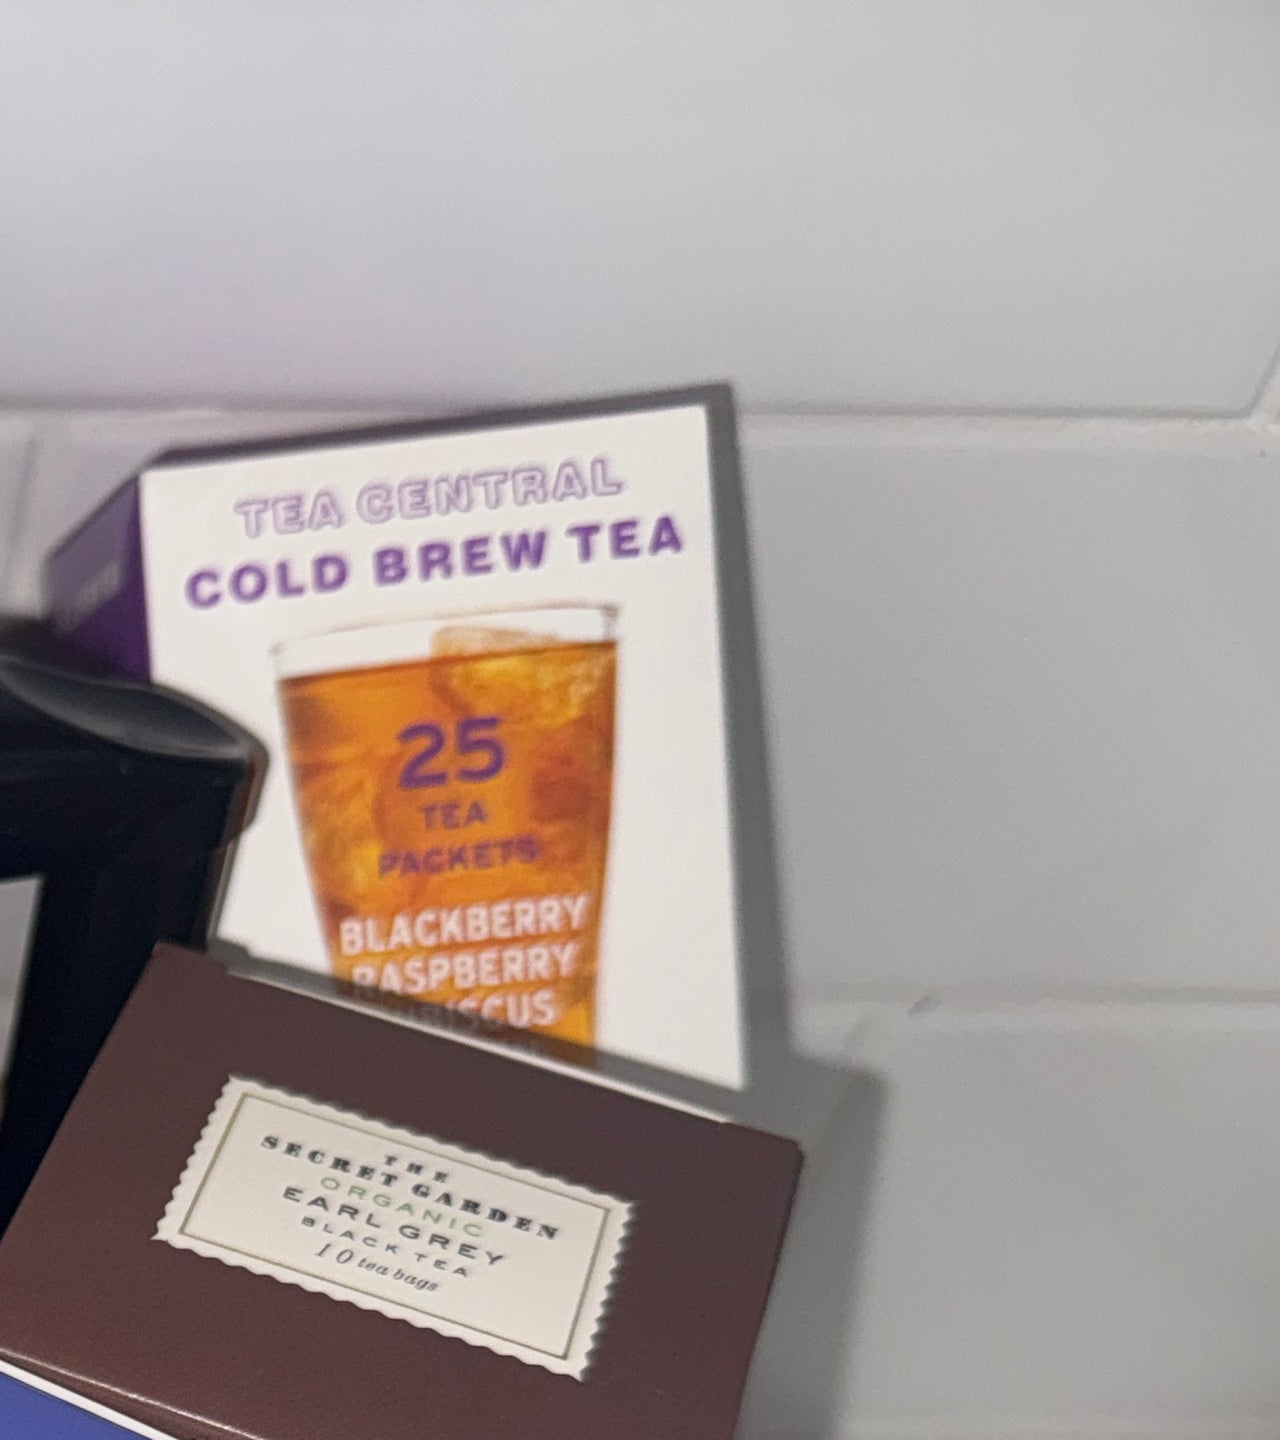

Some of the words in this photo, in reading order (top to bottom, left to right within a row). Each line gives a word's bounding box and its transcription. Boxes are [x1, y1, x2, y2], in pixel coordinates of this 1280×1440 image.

[235, 494, 348, 539] TEA
[357, 456, 624, 524] CENTRAL
[185, 552, 350, 608] COLD
[374, 528, 549, 588] BREW
[566, 515, 684, 564] TEA
[396, 716, 506, 790] 25
[421, 801, 488, 832] TEA
[378, 836, 543, 879] PACKETS
[339, 891, 588, 956] BLACKBERRY
[260, 1134, 399, 1188] SECRET
[411, 1182, 559, 1240] GARDEN
[383, 1155, 450, 1184] THE
[283, 1186, 381, 1229] EARL
[398, 1224, 507, 1267] GREY
[319, 1177, 485, 1238] ORGANIC
[301, 1216, 400, 1255] BLACK
[414, 1252, 469, 1278] TEA
[314, 1242, 354, 1266] 10
[357, 1256, 389, 1279] tea
[391, 1268, 440, 1294] bags
